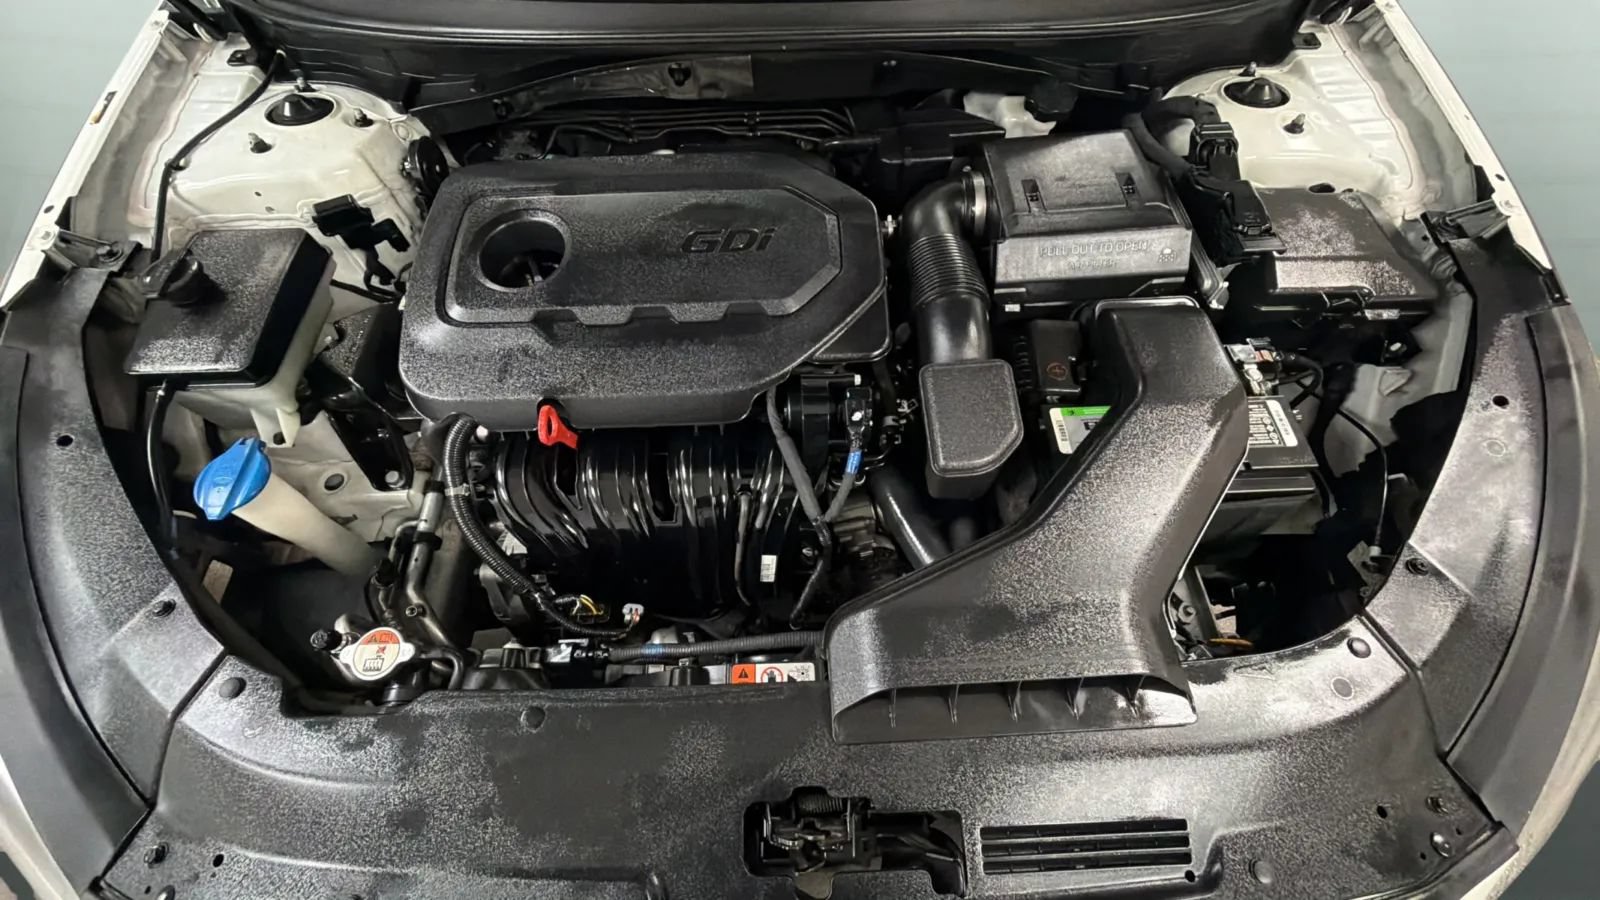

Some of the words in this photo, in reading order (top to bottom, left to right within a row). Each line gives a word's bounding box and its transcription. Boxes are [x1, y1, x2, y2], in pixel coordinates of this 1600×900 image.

[681, 226, 776, 253] GDi
[1040, 246, 1067, 257] PULL
[1071, 243, 1094, 255] OUT
[1099, 241, 1113, 253] TO
[1115, 240, 1147, 252] OPEN
